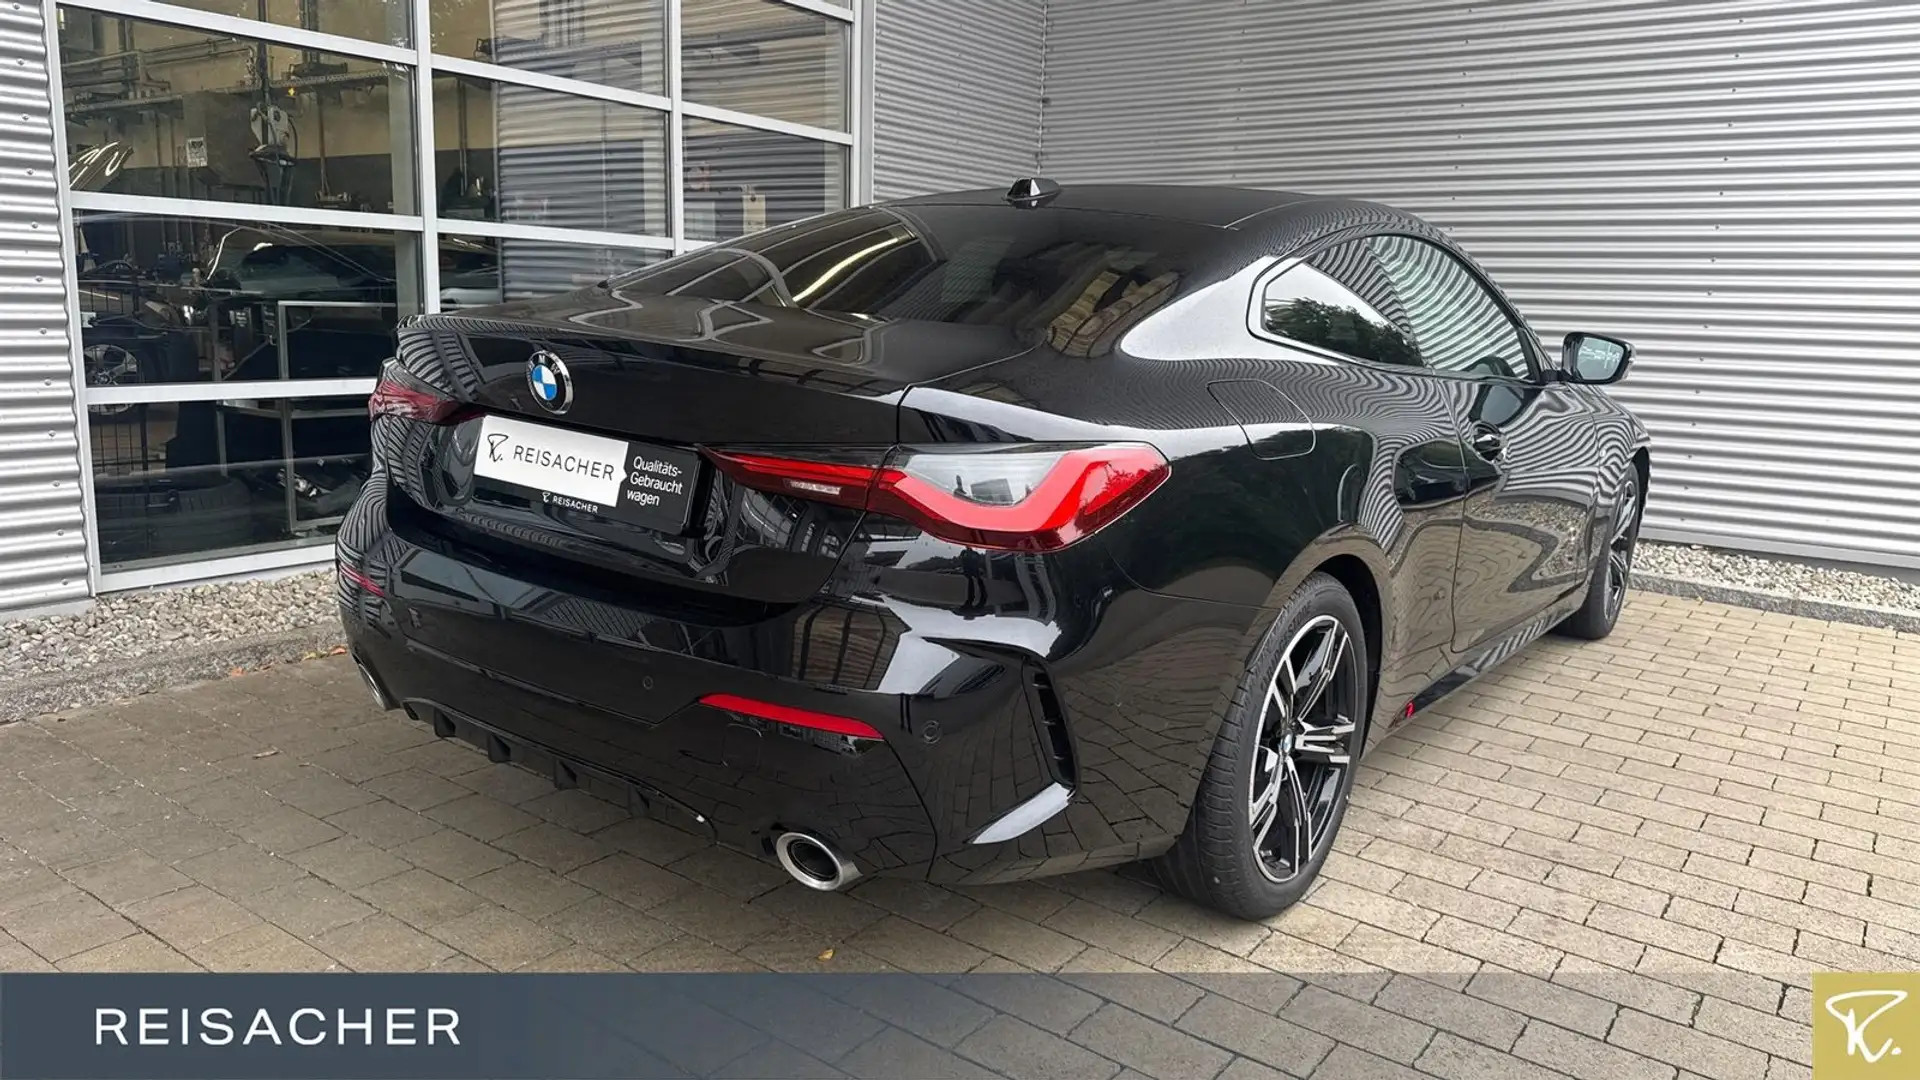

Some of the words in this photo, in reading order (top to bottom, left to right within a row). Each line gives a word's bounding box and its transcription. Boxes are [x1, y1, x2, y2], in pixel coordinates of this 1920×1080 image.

[513, 445, 614, 481] REISACHER
[633, 455, 682, 477] Qualitäts-
[629, 471, 683, 495] Gebraucht
[552, 497, 598, 514] REISACHER
[626, 489, 660, 506] wagen
